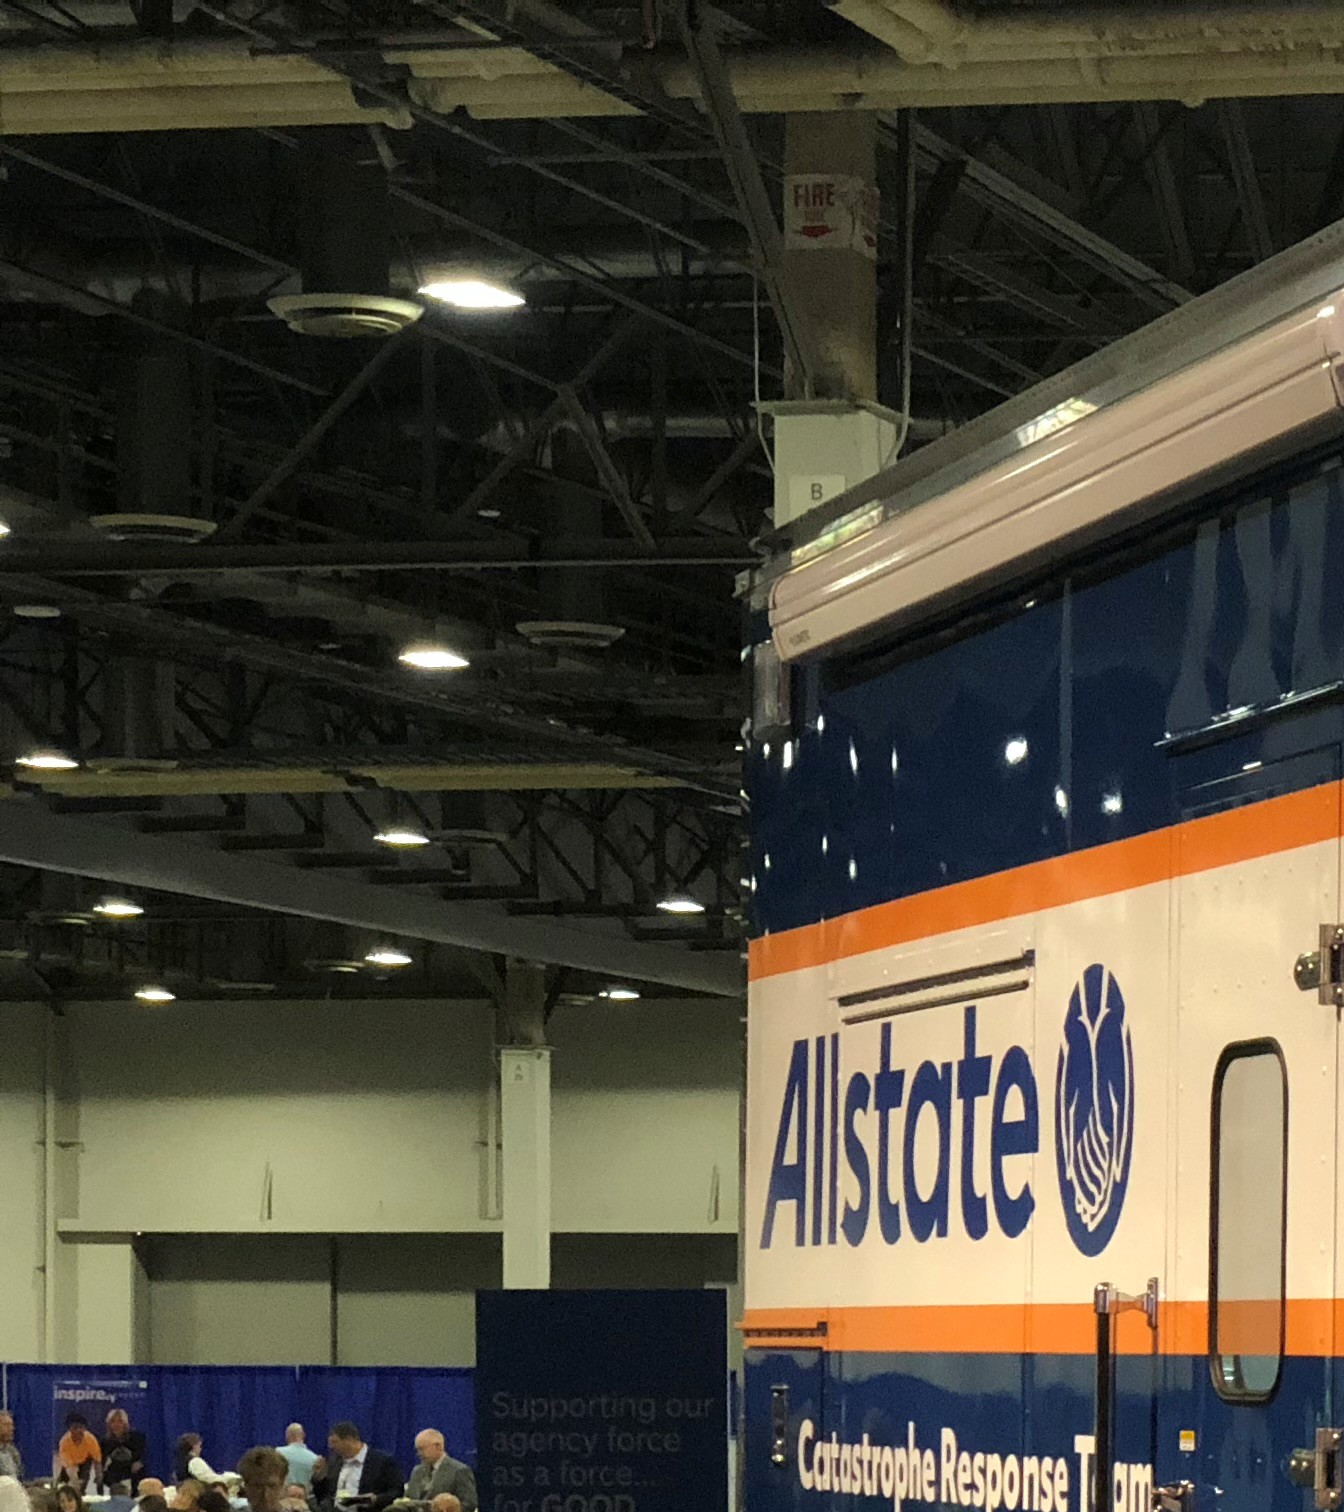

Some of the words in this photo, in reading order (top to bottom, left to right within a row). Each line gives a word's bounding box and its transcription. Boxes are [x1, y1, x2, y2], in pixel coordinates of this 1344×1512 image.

[793, 184, 834, 208] FIRE
[811, 483, 822, 500] B
[760, 1006, 1040, 1250] Allstate
[493, 1391, 656, 1424] Supporting
[665, 1397, 714, 1418] our
[493, 1432, 598, 1457] agency
[608, 1425, 679, 1451] force
[493, 1466, 524, 1487] as
[534, 1466, 550, 1486] a
